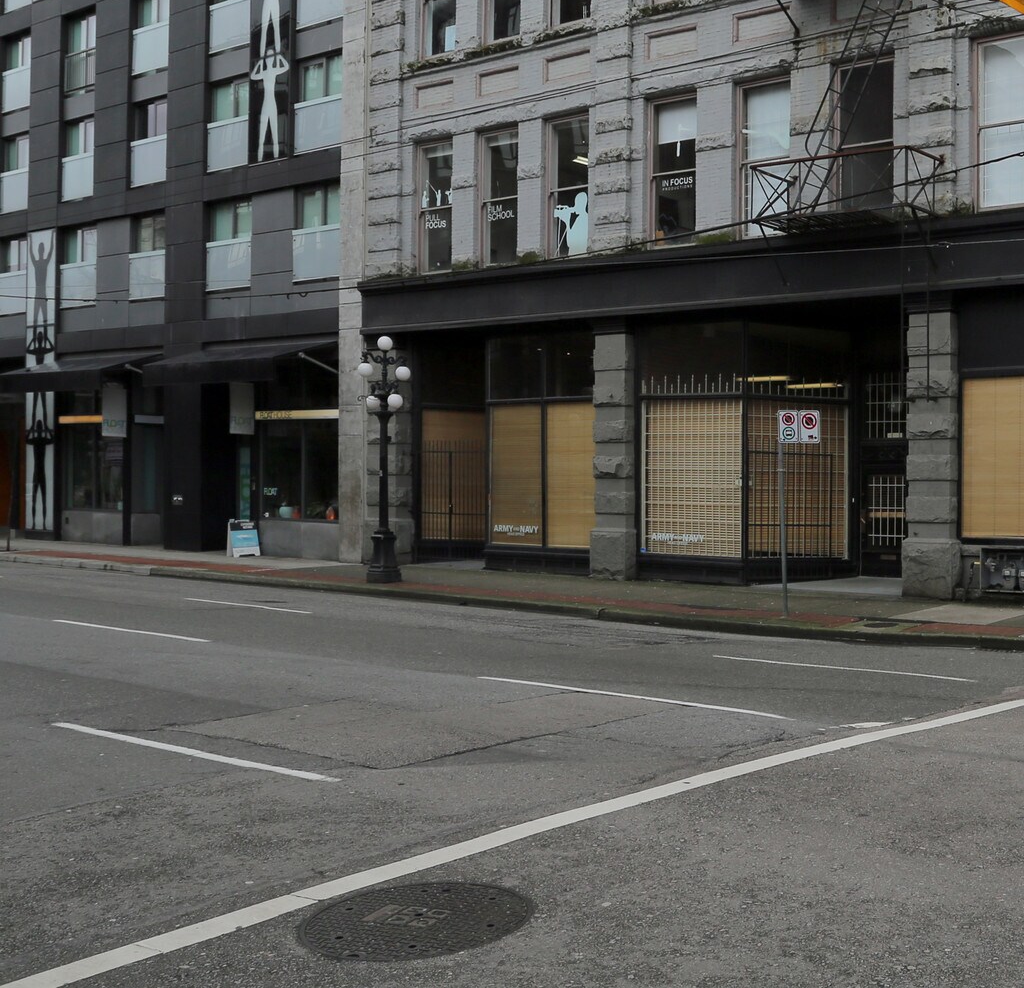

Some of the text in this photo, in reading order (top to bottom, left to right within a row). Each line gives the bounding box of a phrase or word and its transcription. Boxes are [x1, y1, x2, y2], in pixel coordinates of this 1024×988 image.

[670, 177, 693, 186] FOCUS
[488, 205, 502, 213] FILM
[426, 214, 440, 222] PULL
[488, 210, 514, 222] SCHOOL
[426, 220, 446, 229] FOCUS
[493, 524, 513, 533] ARMY
[519, 525, 539, 534] NAVY
[651, 532, 673, 541] ARMY
[682, 534, 705, 543] NAVY
